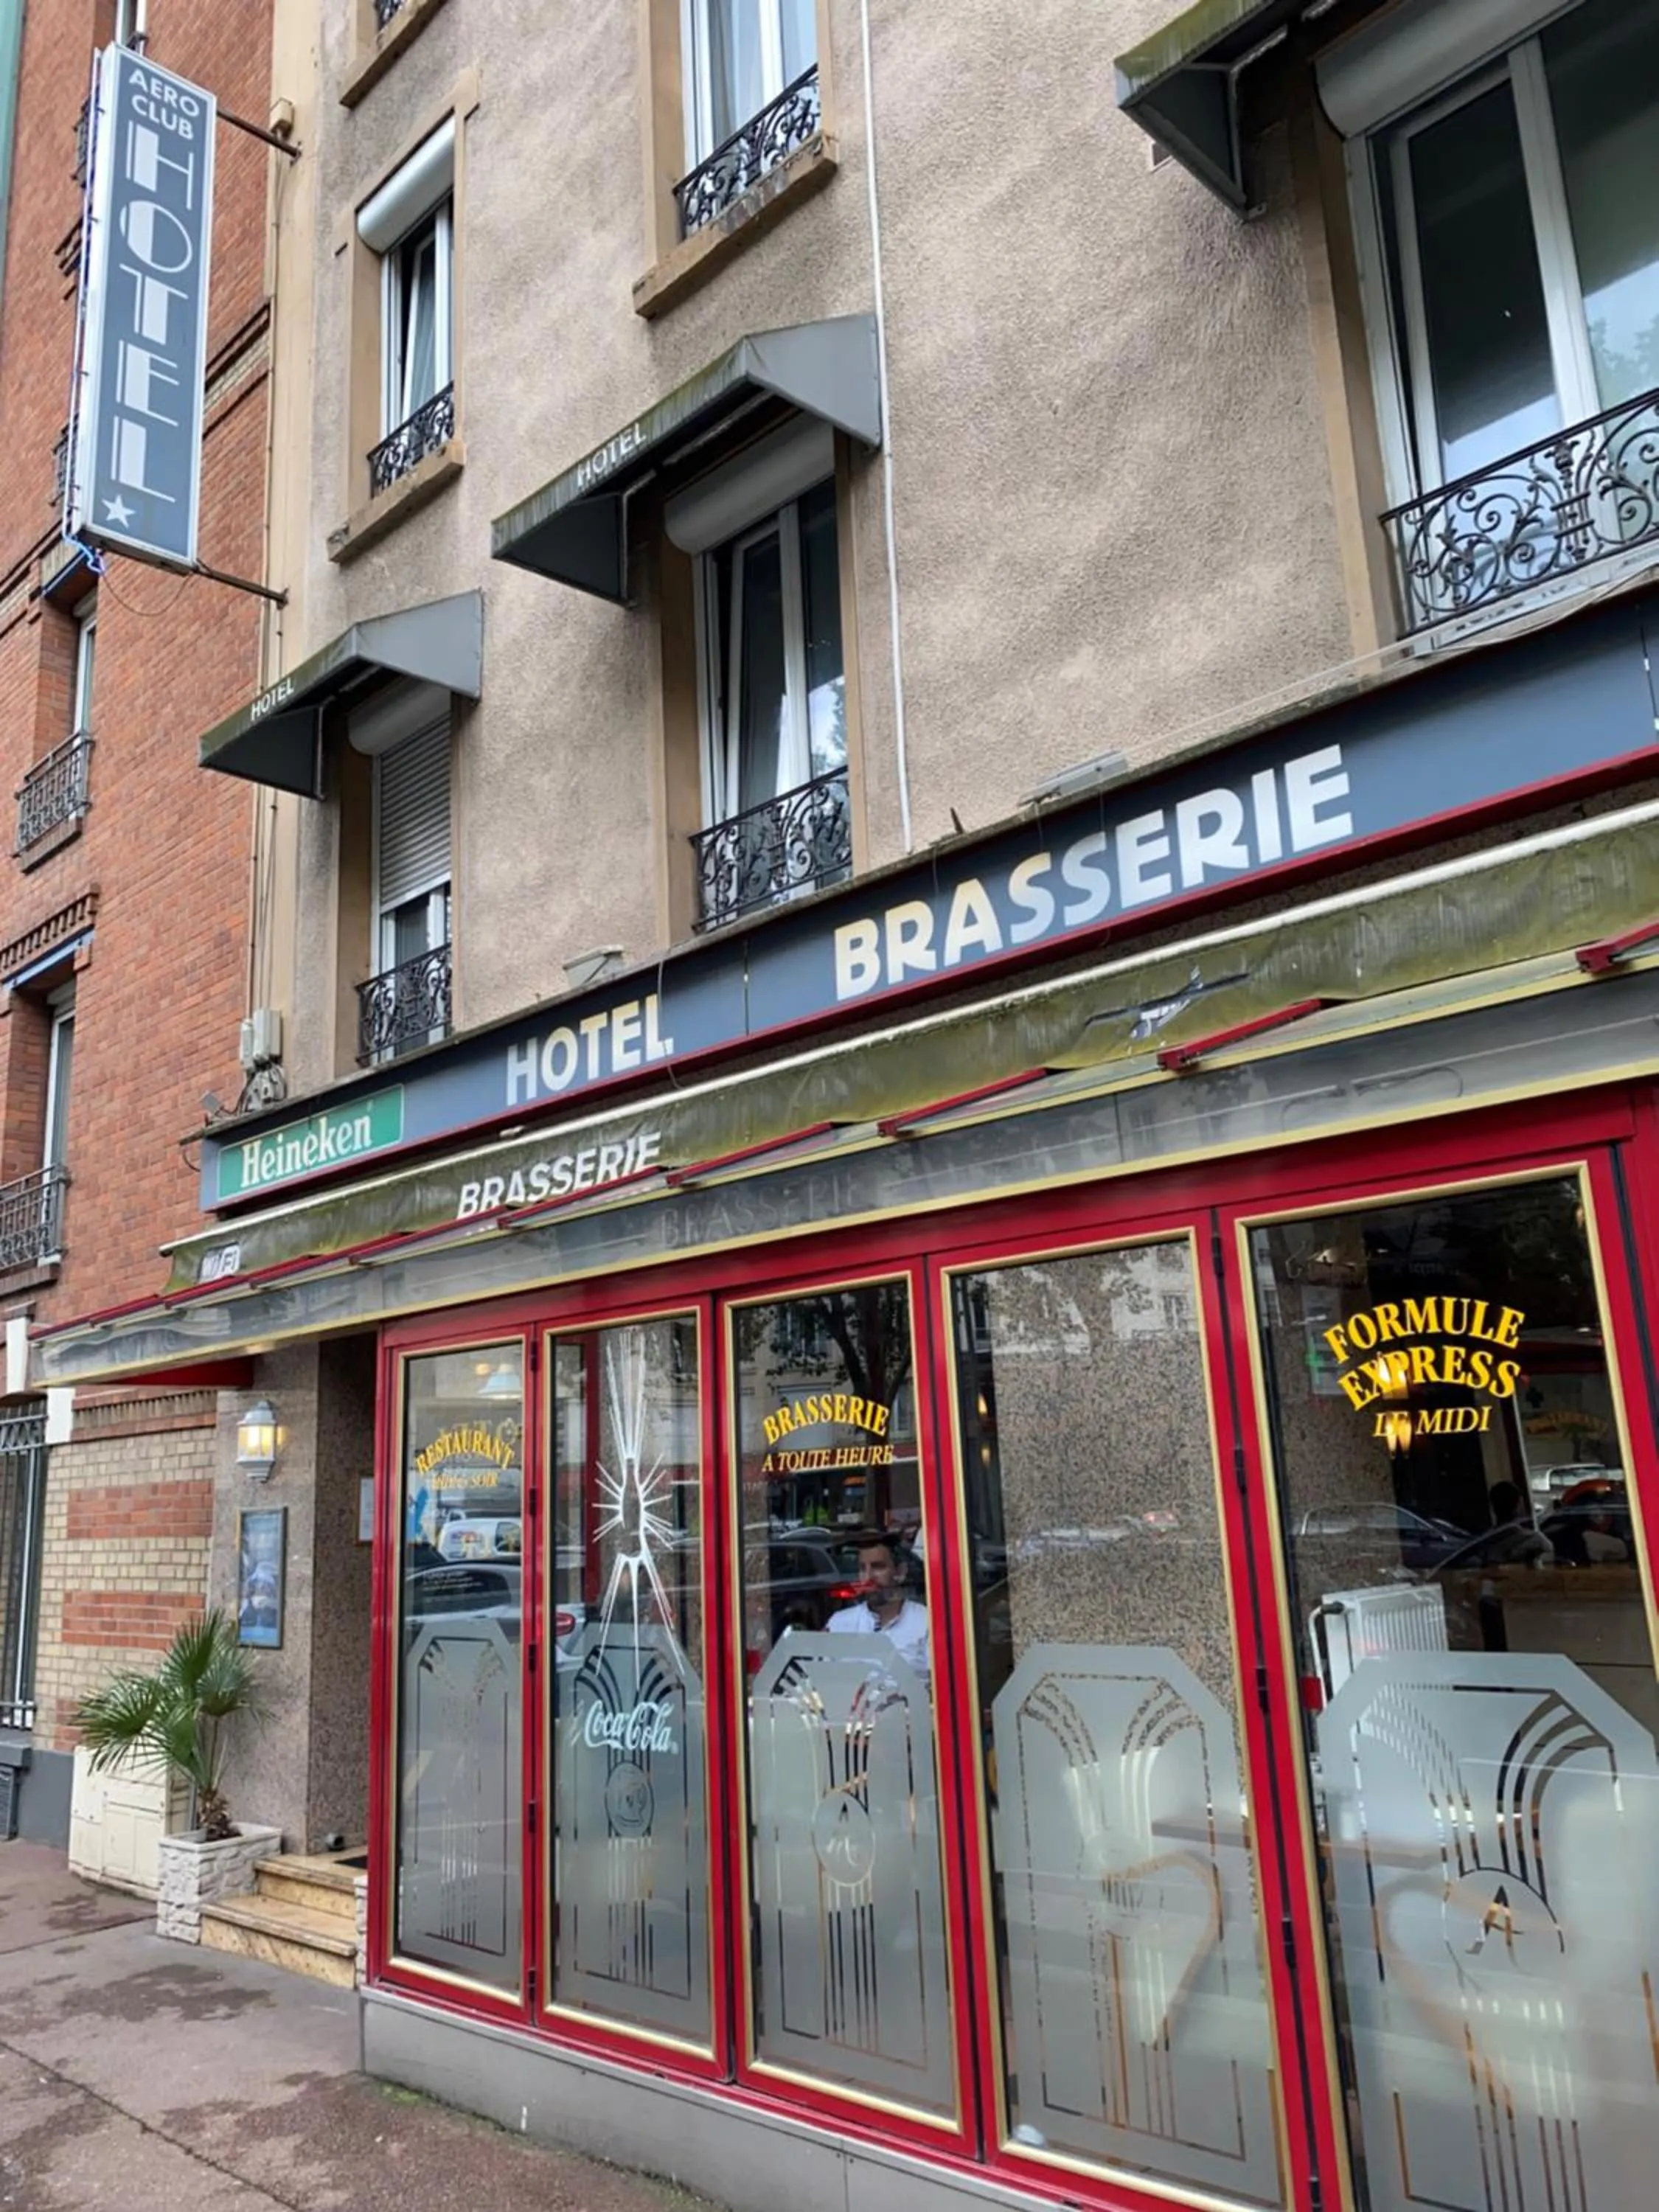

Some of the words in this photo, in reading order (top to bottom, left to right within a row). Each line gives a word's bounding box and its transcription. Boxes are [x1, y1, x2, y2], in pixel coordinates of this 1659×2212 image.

[128, 68, 200, 119] AERO
[131, 94, 194, 141] CLUB
[111, 120, 193, 503] HOTEL
[576, 422, 647, 489] HOTEL
[251, 678, 294, 722] HOTEL
[834, 743, 1353, 1001] BRASSERIE
[506, 994, 674, 1106] HOTEL
[240, 1115, 372, 1189] Heineken
[456, 1133, 662, 1221] BRASSERIE
[1324, 1295, 1526, 1365] FORMULE
[1338, 1346, 1521, 1411] EXPRESS
[415, 1429, 515, 1475] RESTAURANT
[762, 1393, 890, 1446] BRASSERIE
[1414, 1406, 1492, 1435] MIDI
[762, 1453, 773, 1472] A
[778, 1449, 833, 1472] TOUTE
[835, 1444, 894, 1467] HEURE
